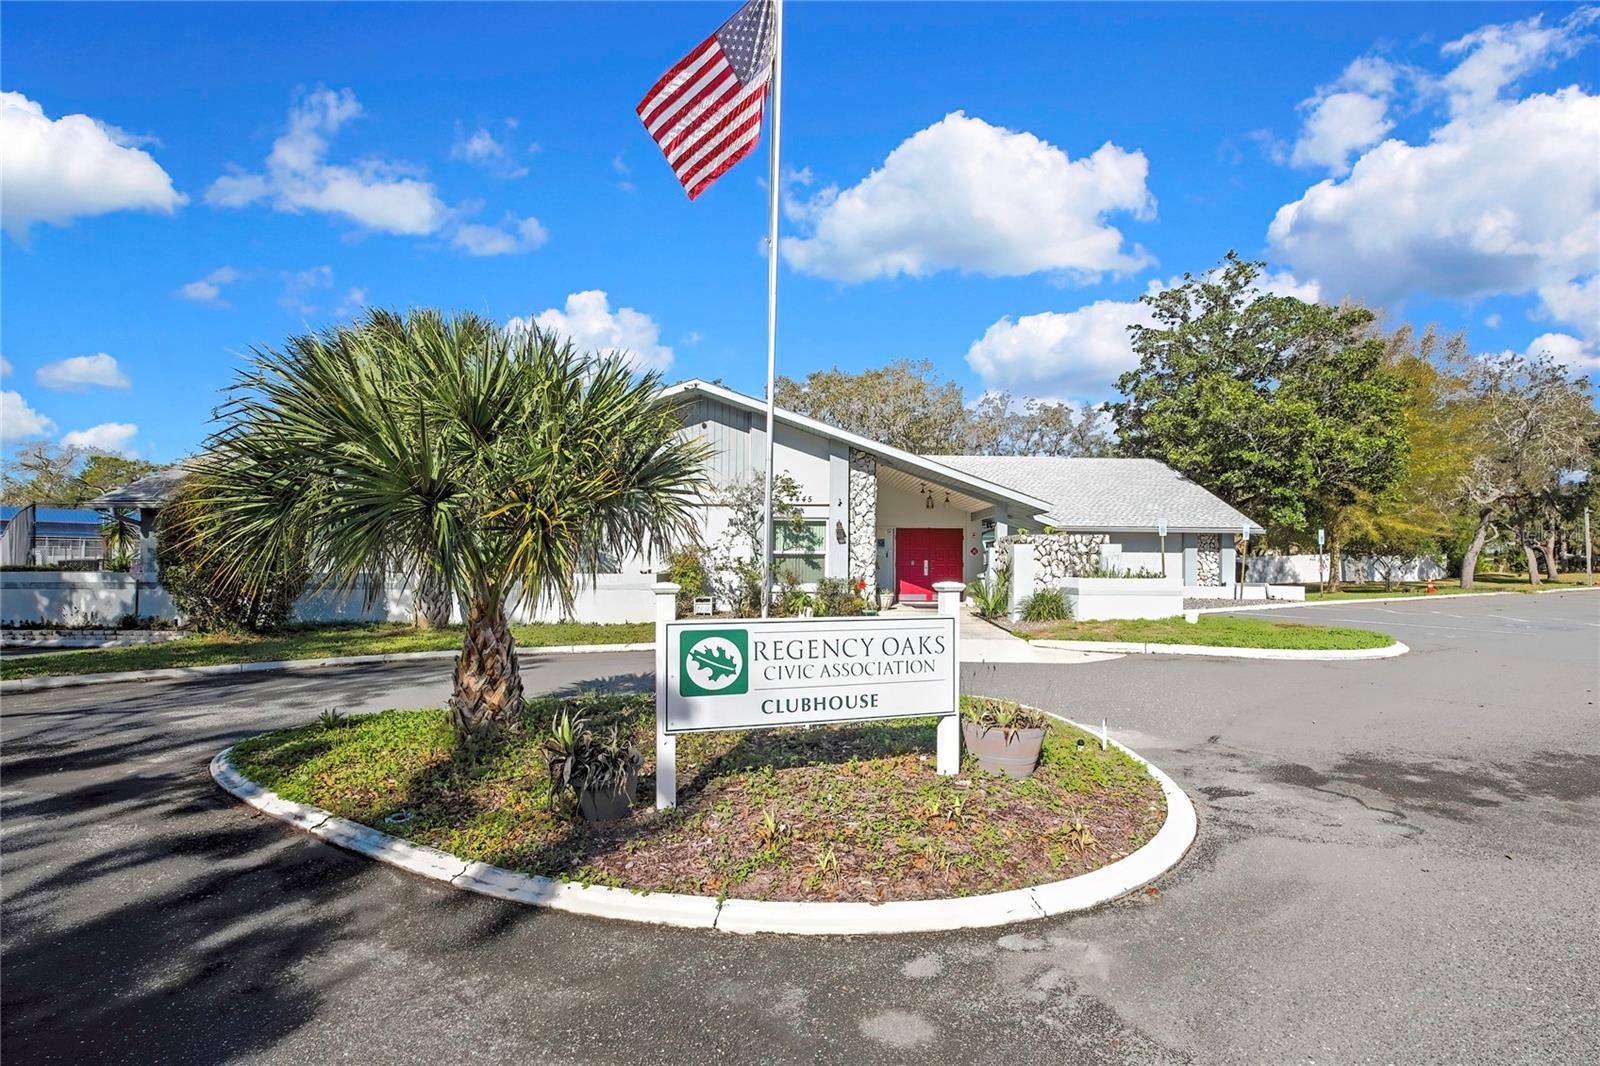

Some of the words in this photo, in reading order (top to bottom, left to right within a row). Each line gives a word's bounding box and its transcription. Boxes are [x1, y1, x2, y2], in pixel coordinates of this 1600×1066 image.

[753, 638, 874, 661] REGENCY
[882, 635, 945, 656] OAKS
[764, 664, 815, 681] CIVIC
[820, 659, 936, 679] ASSOCIATION
[761, 694, 879, 715] CLUBHOUSE
